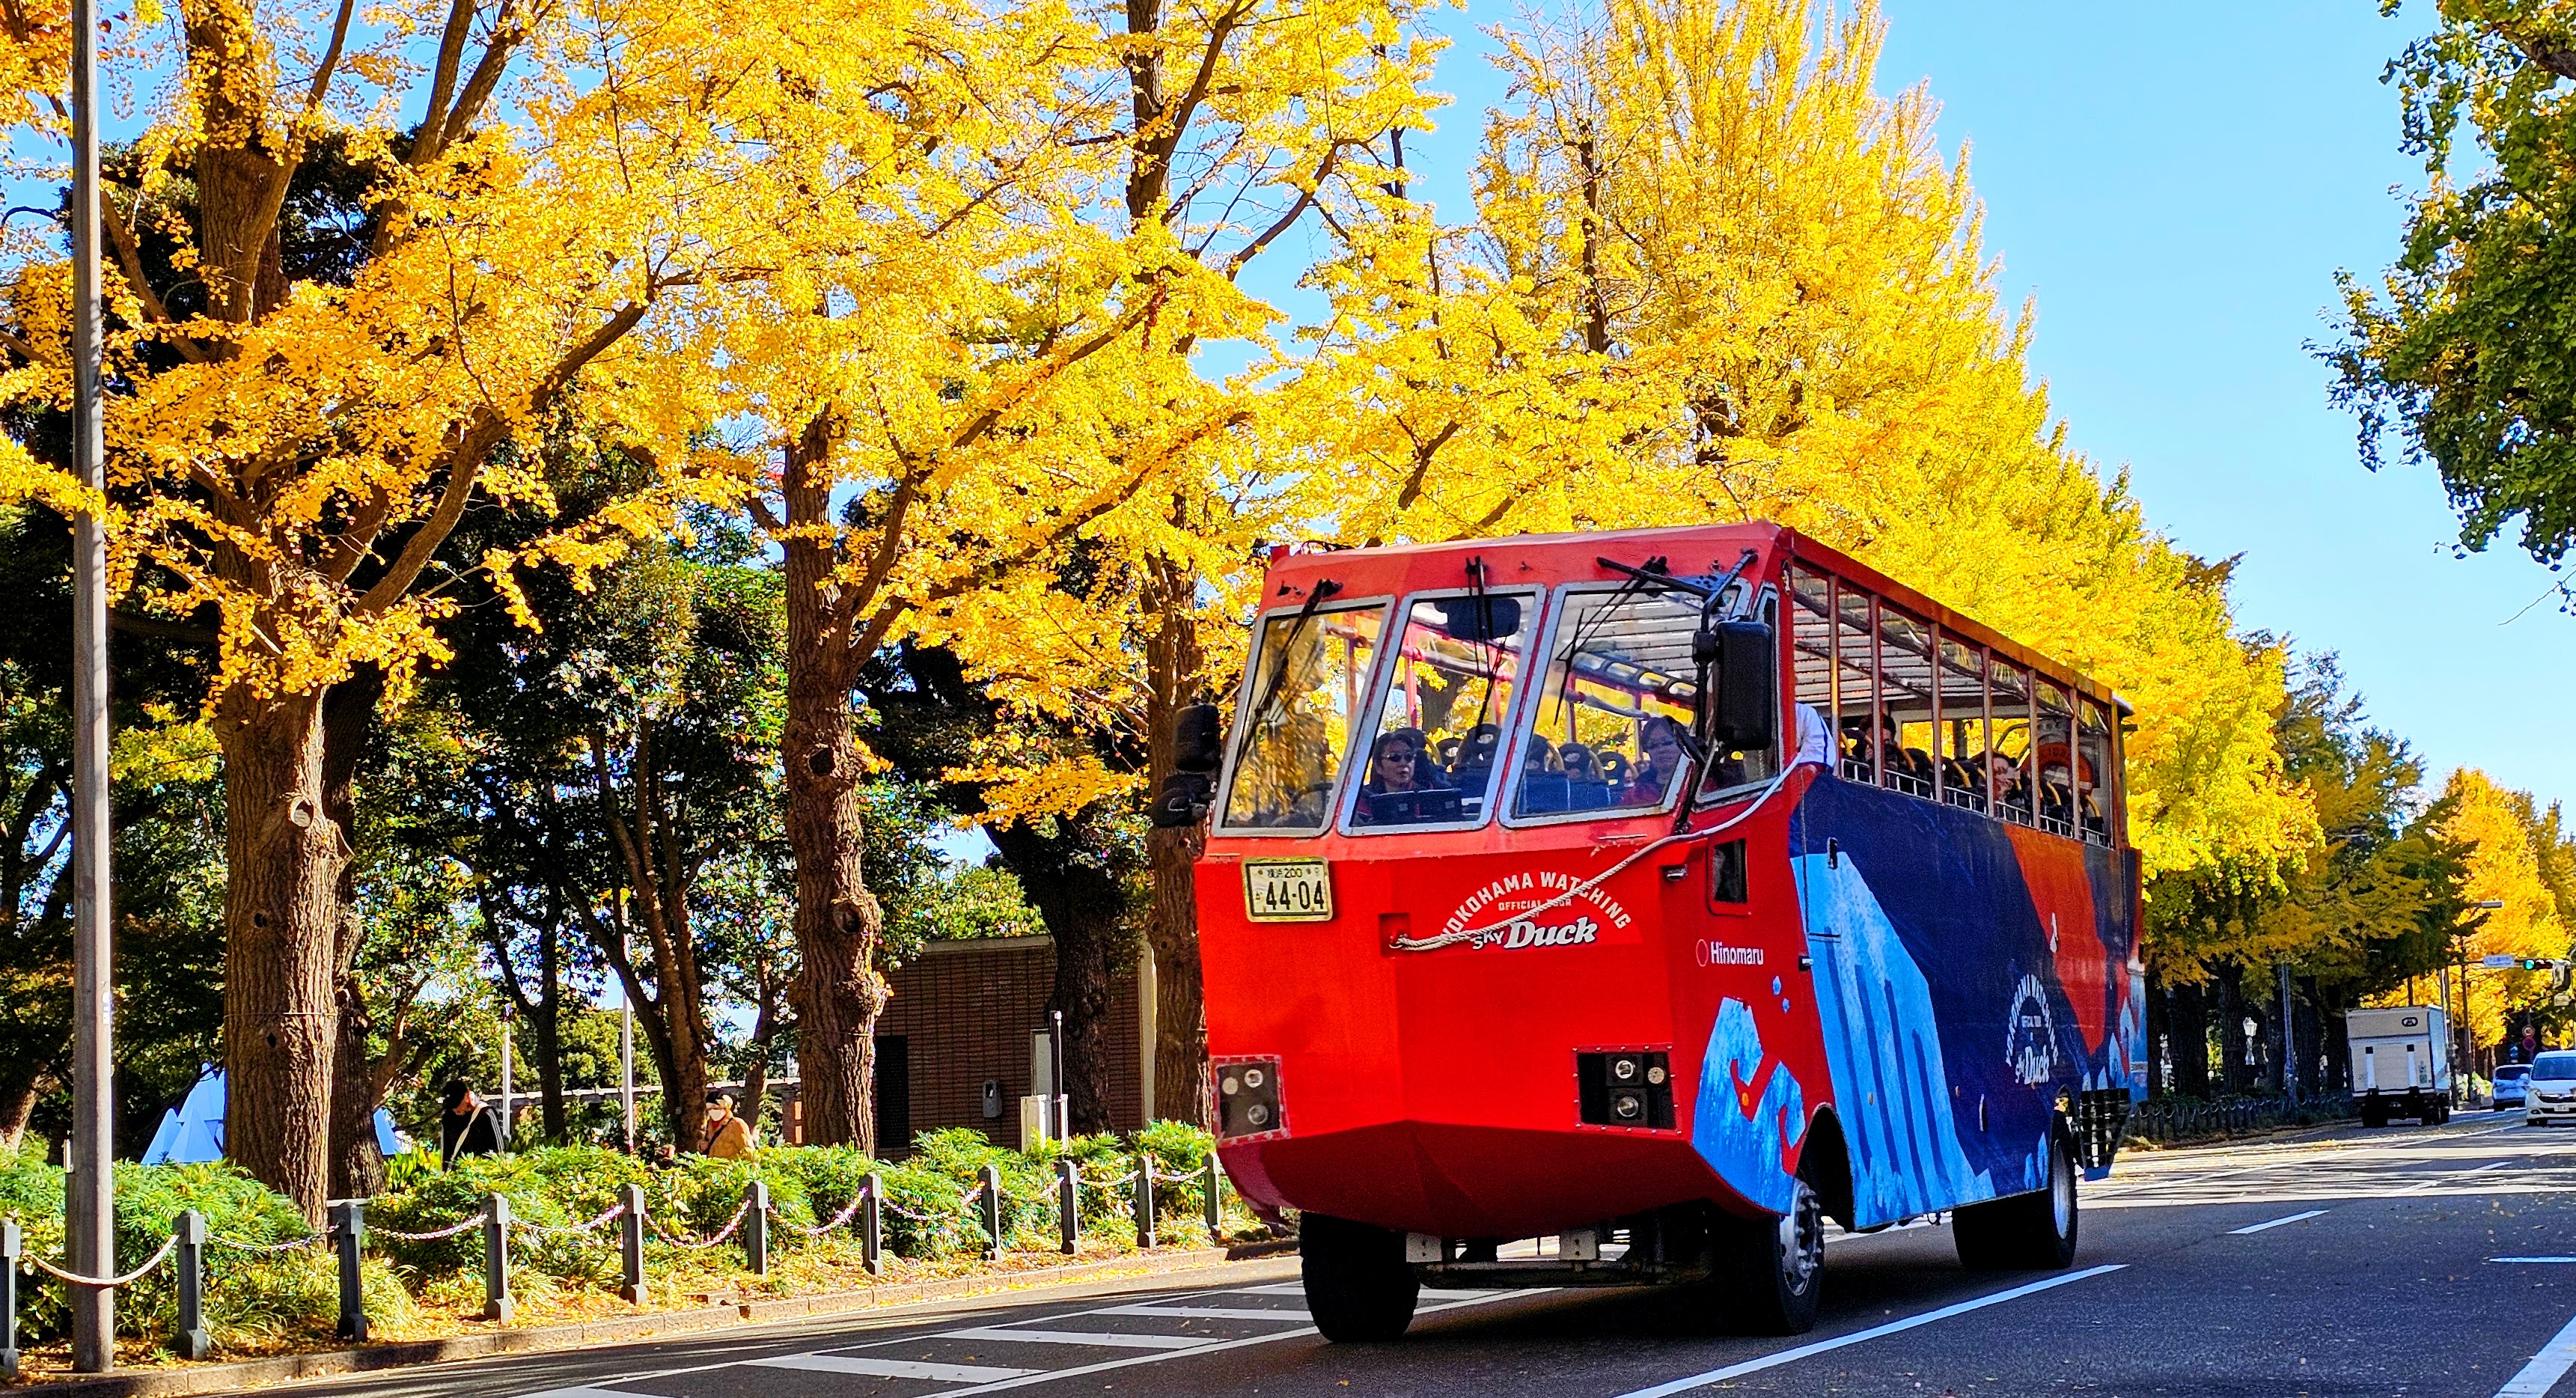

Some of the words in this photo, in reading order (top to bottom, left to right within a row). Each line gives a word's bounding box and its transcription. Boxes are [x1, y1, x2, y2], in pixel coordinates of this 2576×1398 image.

[1284, 867, 1302, 878] 200
[1498, 900, 1542, 911] OFFICIAL
[1504, 916, 1598, 950] Duck
[1710, 941, 1764, 965] Hinomaru
